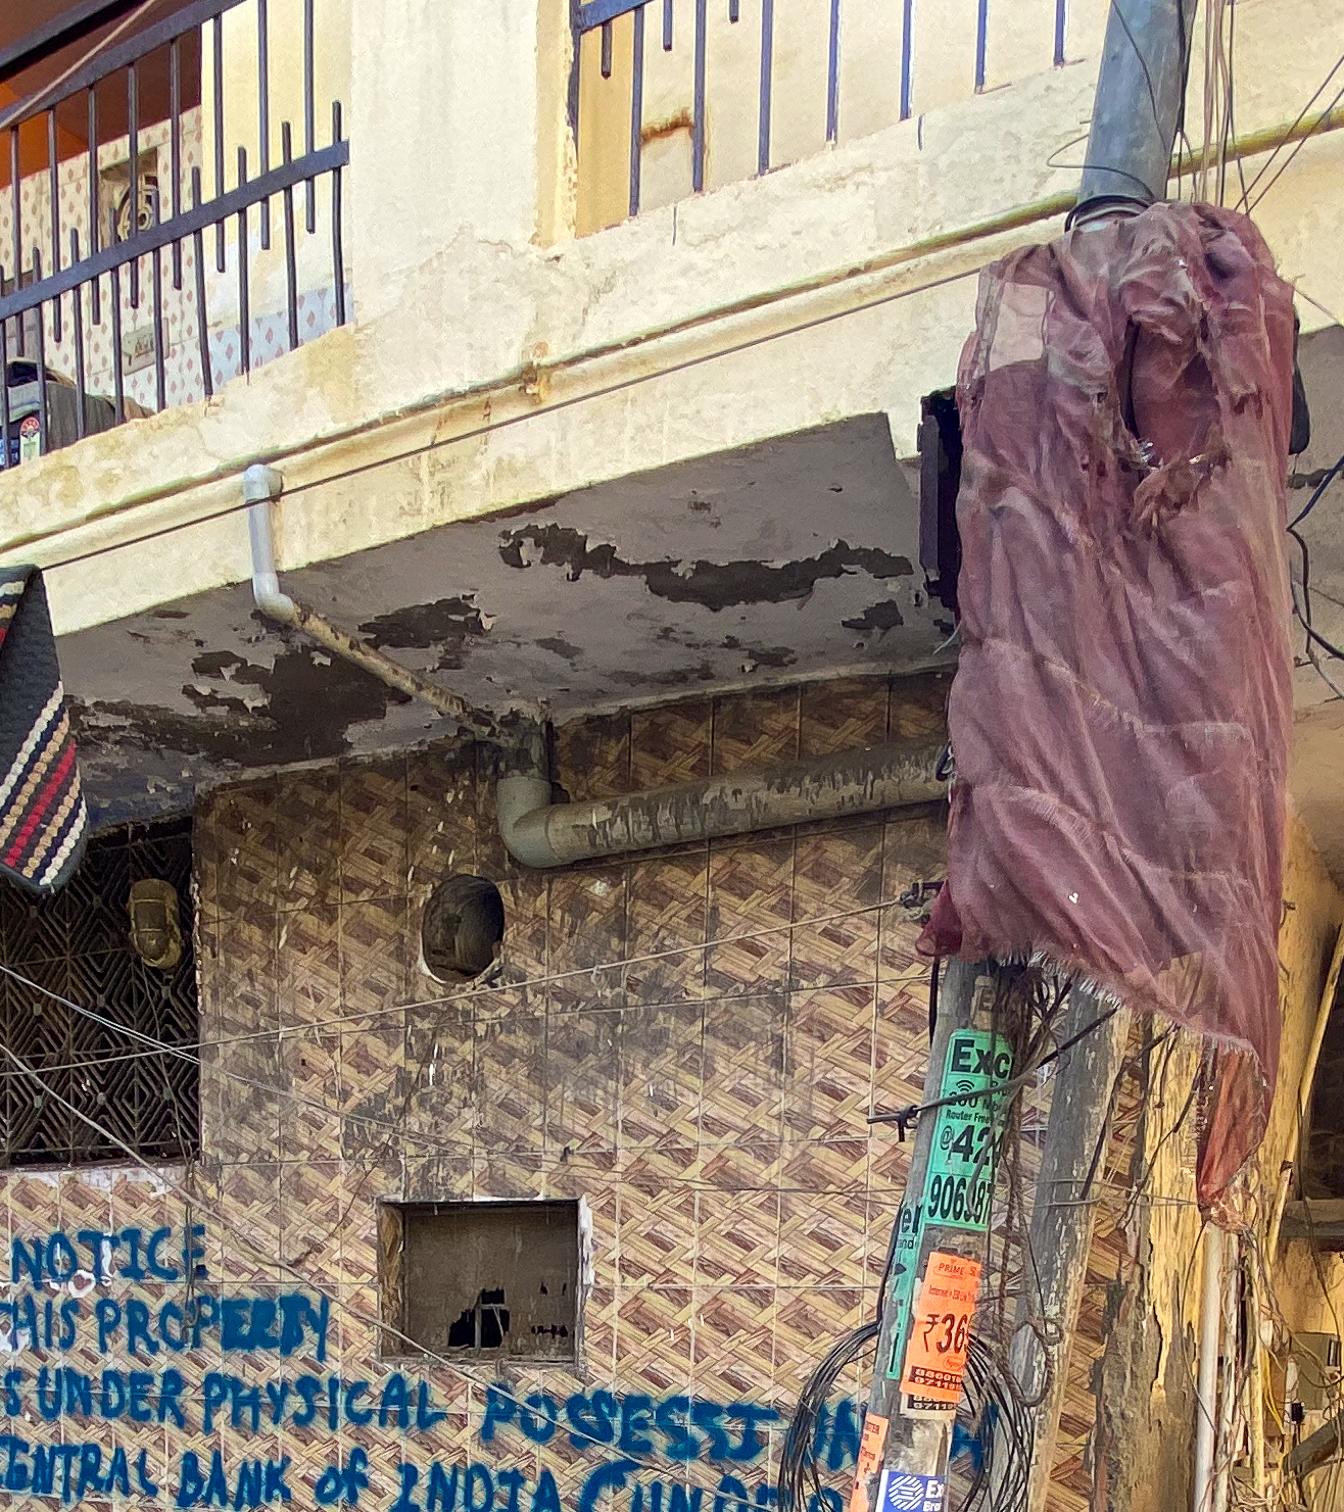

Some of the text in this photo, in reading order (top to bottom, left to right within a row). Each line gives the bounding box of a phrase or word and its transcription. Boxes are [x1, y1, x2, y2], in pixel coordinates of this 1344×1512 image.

[10, 1224, 208, 1291] NOTICE
[37, 1367, 186, 1430] UNDER
[202, 1371, 452, 1433] PHYSICAL
[177, 1447, 293, 1512] BANK
